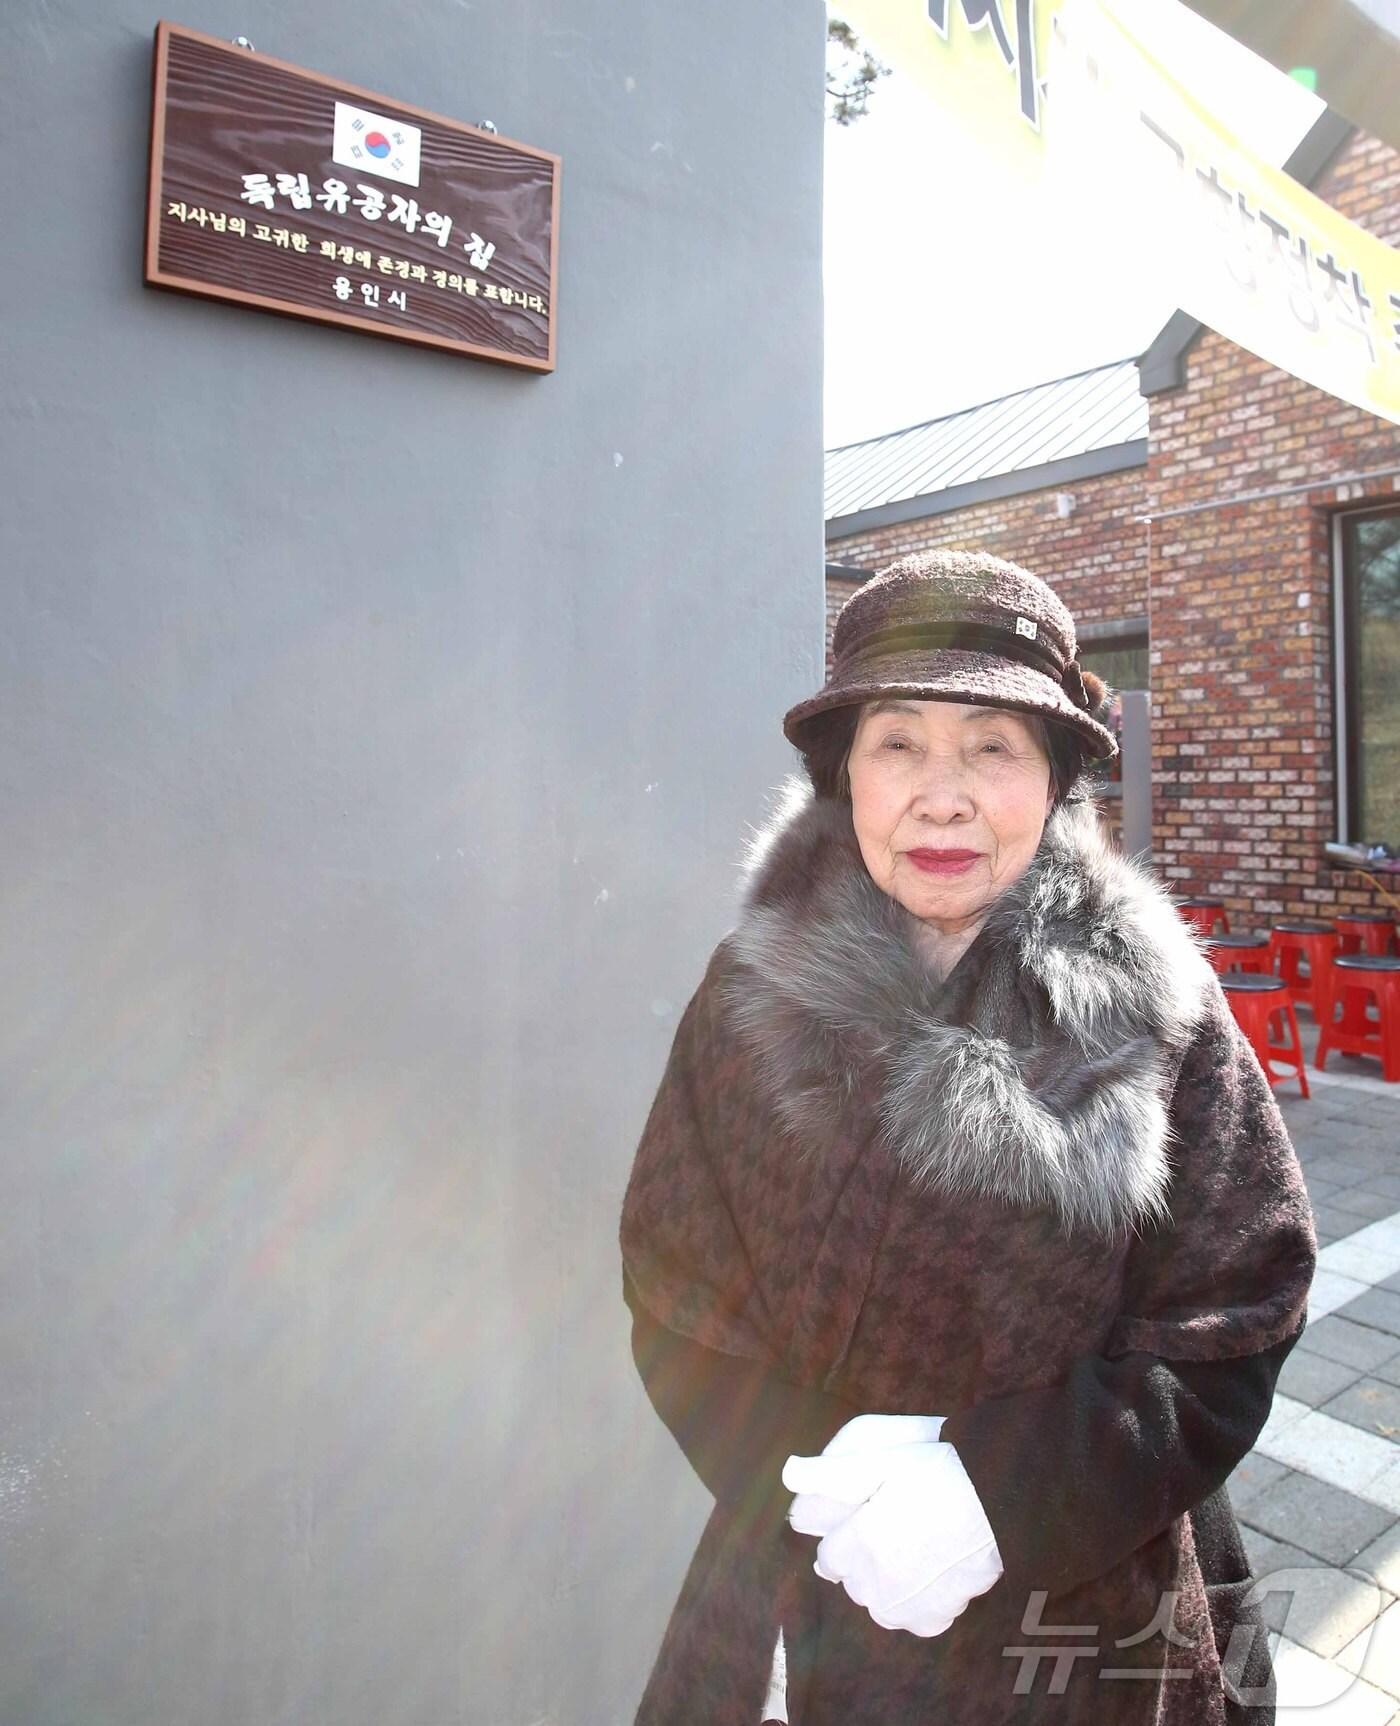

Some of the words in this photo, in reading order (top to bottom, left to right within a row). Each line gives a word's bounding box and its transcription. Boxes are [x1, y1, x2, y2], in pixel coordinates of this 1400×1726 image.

[168, 202, 246, 237] 지사님의
[252, 223, 310, 253] 고귀한
[319, 240, 372, 269] 희생에
[377, 255, 428, 283] 존경과
[432, 269, 479, 296] 경의를
[483, 283, 547, 314] 표합니다.
[240, 172, 453, 247] 독립유공자의
[464, 232, 496, 271] 집
